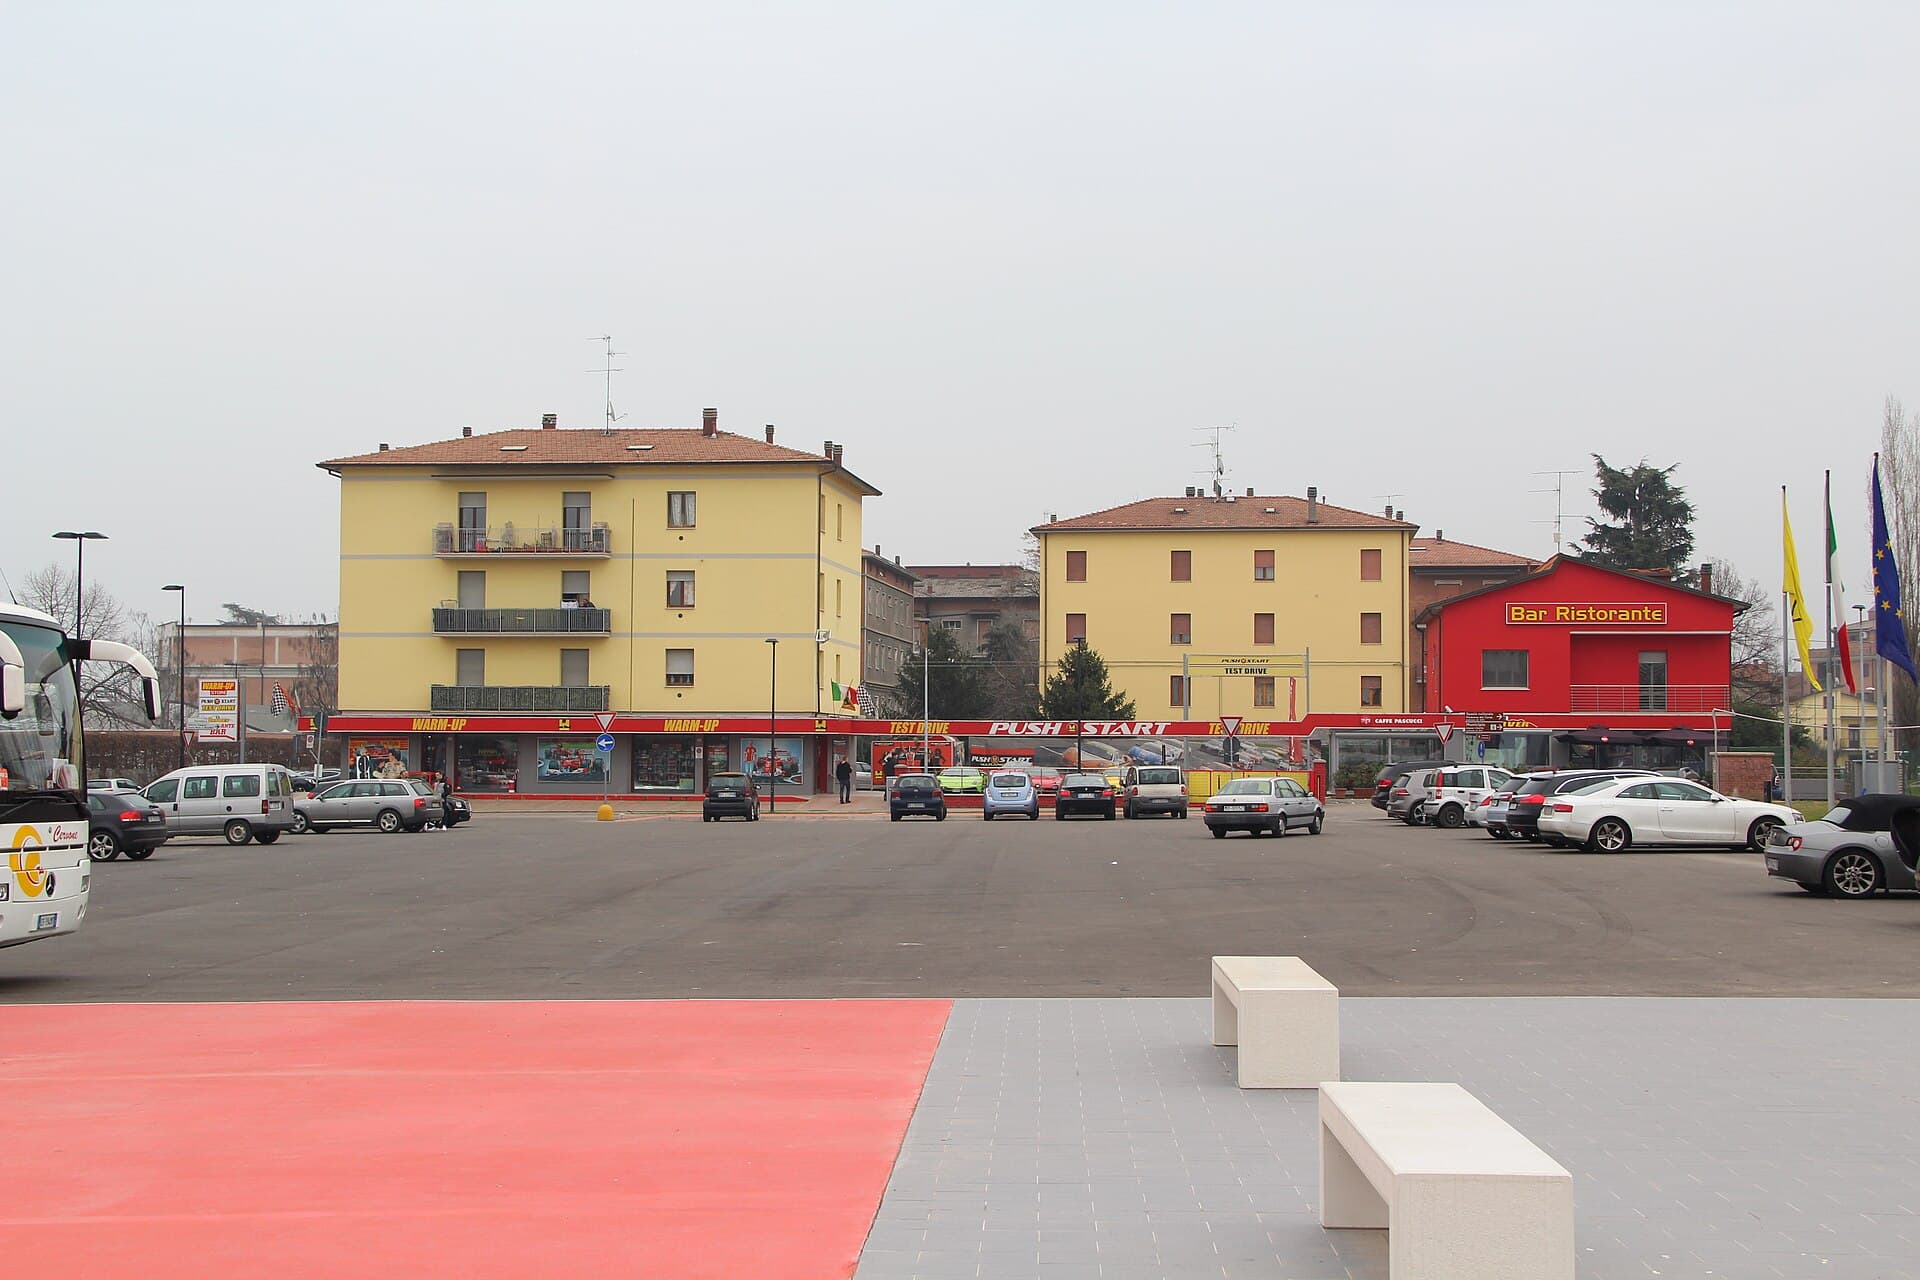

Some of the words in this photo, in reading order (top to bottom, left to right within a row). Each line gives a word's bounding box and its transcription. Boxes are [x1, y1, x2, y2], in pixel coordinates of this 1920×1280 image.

[1511, 606, 1547, 621] Bar
[1556, 606, 1662, 621] Ristorante
[1225, 667, 1242, 675] TEST
[1244, 667, 1267, 675] DRIVE
[412, 718, 467, 731] WARM-UP
[663, 719, 720, 732] WARM-UP
[889, 721, 917, 734] TEST
[916, 722, 950, 734] DRIVE
[988, 722, 1063, 735] PUSH
[1081, 722, 1171, 735] START
[971, 755, 991, 763] PUSH
